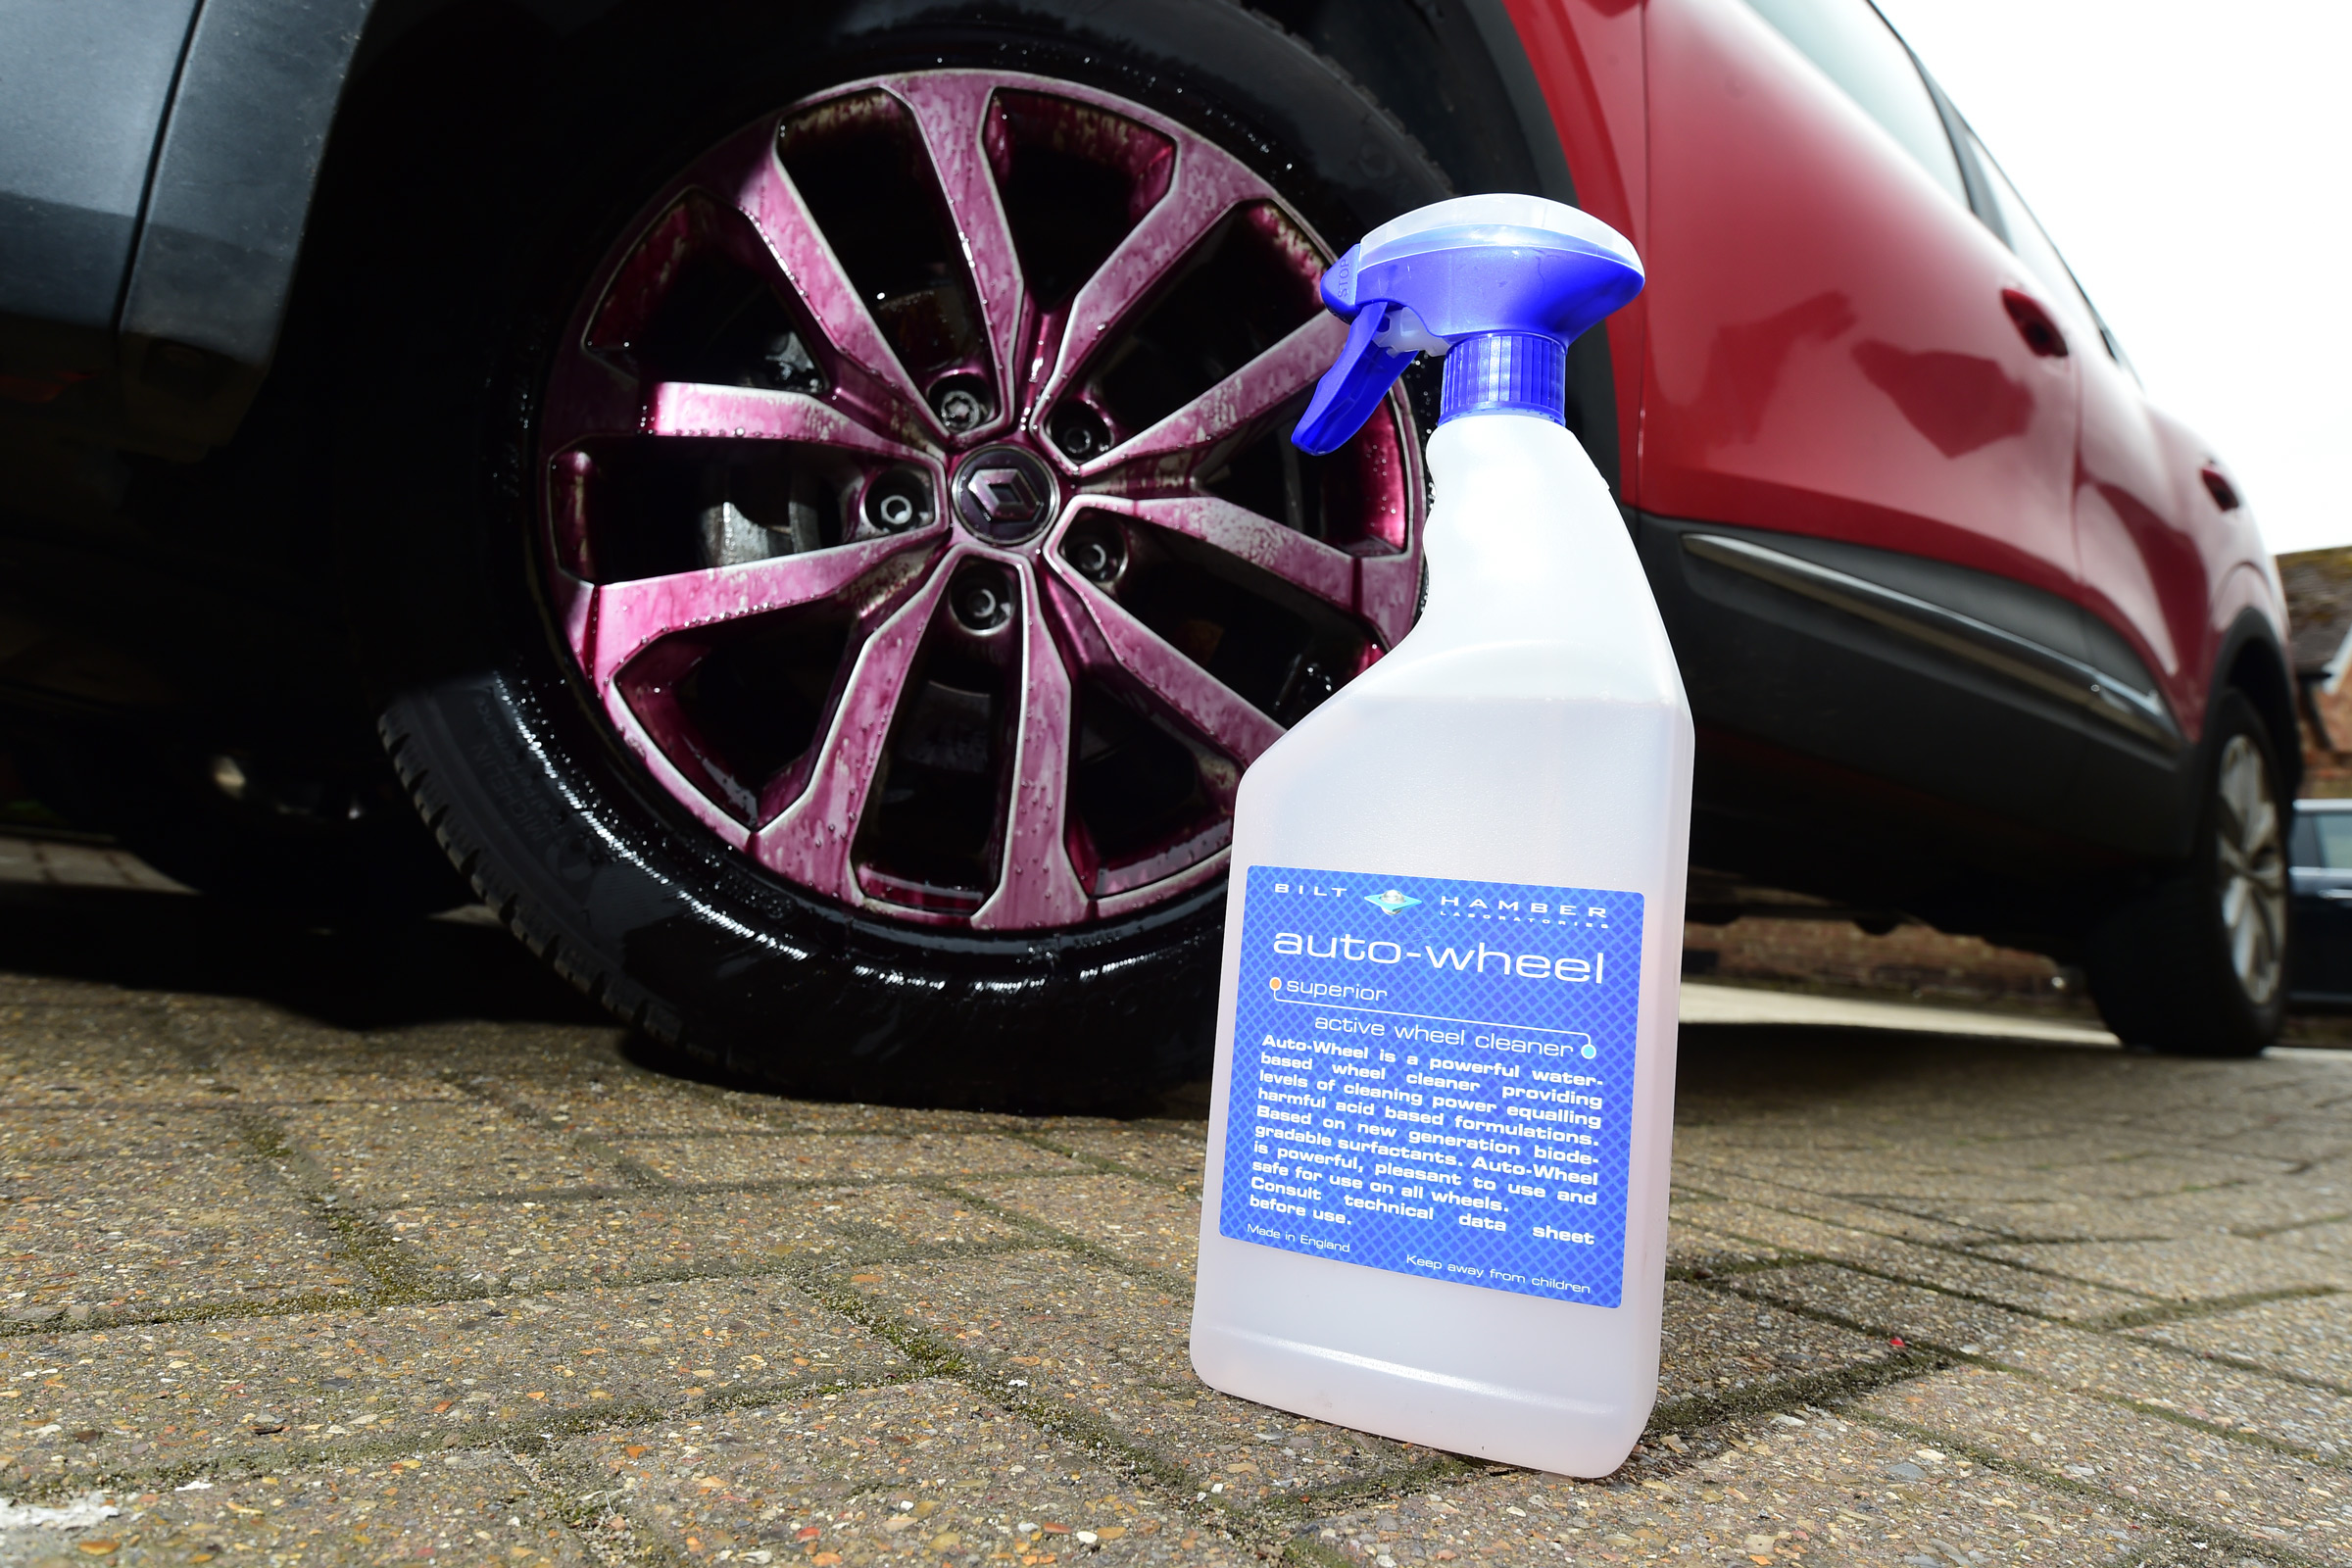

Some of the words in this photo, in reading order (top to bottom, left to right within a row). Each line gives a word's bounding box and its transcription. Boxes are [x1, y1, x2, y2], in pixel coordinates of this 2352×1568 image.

[1337, 259, 1350, 298] STOP
[470, 744, 551, 841] MICHELIN
[1274, 883, 1347, 897] BILT
[1441, 896, 1606, 918] HAMBER
[1440, 910, 1608, 928] LABORATORIES
[1273, 932, 1603, 984] auto-wheel
[1286, 980, 1387, 1001] superior
[1261, 1034, 1368, 1058] Auto-Wheel
[1379, 1048, 1396, 1062] is
[1406, 1054, 1418, 1065] a
[1429, 1057, 1519, 1078] powerful
[1531, 1070, 1603, 1086] water-
[1314, 1016, 1385, 1036] active
[1394, 1024, 1464, 1046] wheel
[1475, 1032, 1573, 1056] cleaner
[1259, 1068, 1307, 1088] levels
[1316, 1078, 1336, 1091] of
[1343, 1082, 1422, 1105] cleaning
[1432, 1096, 1496, 1112] power
[1506, 1105, 1601, 1129] equalling
[1260, 1051, 1312, 1070] based
[1331, 1062, 1386, 1080] wheel
[1405, 1071, 1480, 1091] cleaner
[1501, 1086, 1602, 1109] providing
[1256, 1104, 1311, 1125] Based
[1322, 1117, 1346, 1130] on
[1357, 1123, 1396, 1137] new
[1408, 1130, 1520, 1155] generation
[1534, 1144, 1598, 1164] biode-
[1257, 1086, 1326, 1108] harmful
[1335, 1102, 1374, 1115] acid
[1385, 1104, 1444, 1125] based
[1454, 1114, 1598, 1146] formulations.
[1253, 1140, 1268, 1153] is
[1277, 1148, 1363, 1173] powerful,
[1374, 1161, 1461, 1185] pleasant
[1472, 1176, 1495, 1191] to
[1507, 1183, 1545, 1198] use
[1556, 1191, 1596, 1205] and
[1254, 1125, 1331, 1147] gradable
[1337, 1139, 1462, 1166] surfactants.
[1471, 1155, 1597, 1185] Auto-Wheel
[1250, 1194, 1305, 1216] before
[1312, 1209, 1351, 1225] use.
[1250, 1176, 1321, 1200] Consult
[1344, 1194, 1434, 1220] technical
[1458, 1212, 1506, 1231] data
[1532, 1225, 1594, 1245] sheet
[1251, 1160, 1289, 1176] safe
[1295, 1165, 1322, 1181] for
[1329, 1174, 1362, 1189] use
[1369, 1181, 1394, 1194] on
[1400, 1185, 1423, 1199] all
[1431, 1191, 1508, 1212] wheels.
[1247, 1223, 1280, 1239] Made
[1285, 1231, 1295, 1241] in
[1299, 1234, 1349, 1252] England
[1406, 1253, 1442, 1270] Keep
[1447, 1263, 1484, 1278] away
[1490, 1268, 1525, 1283] from
[1531, 1277, 1590, 1293] children
